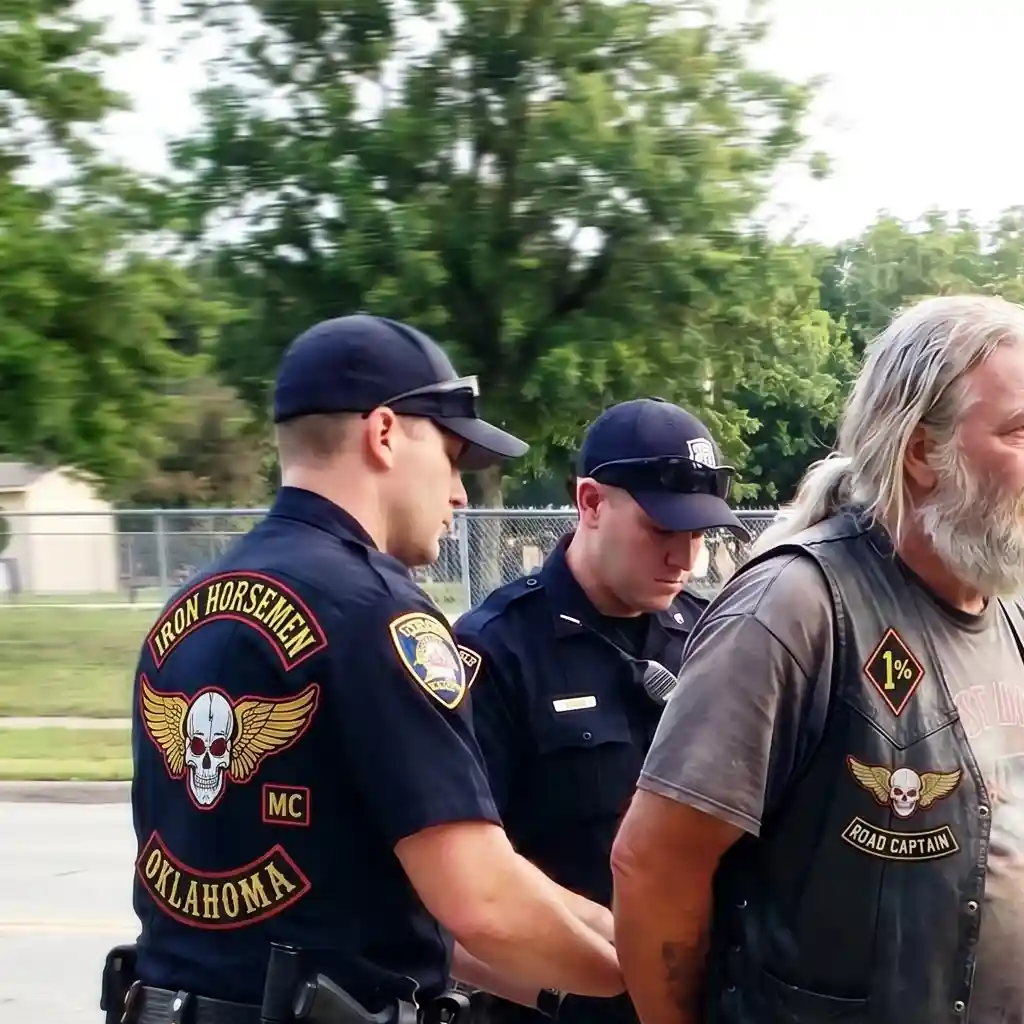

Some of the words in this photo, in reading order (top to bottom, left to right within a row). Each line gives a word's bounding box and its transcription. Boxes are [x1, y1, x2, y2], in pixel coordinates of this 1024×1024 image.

[154, 592, 200, 656] IRON
[205, 580, 316, 658] HORSEMEN
[882, 650, 912, 690] 1%
[268, 792, 302, 818] MC
[849, 824, 887, 851] ROAD
[890, 833, 950, 854] CAPTAIN
[145, 848, 297, 919] OKLAHOMA
